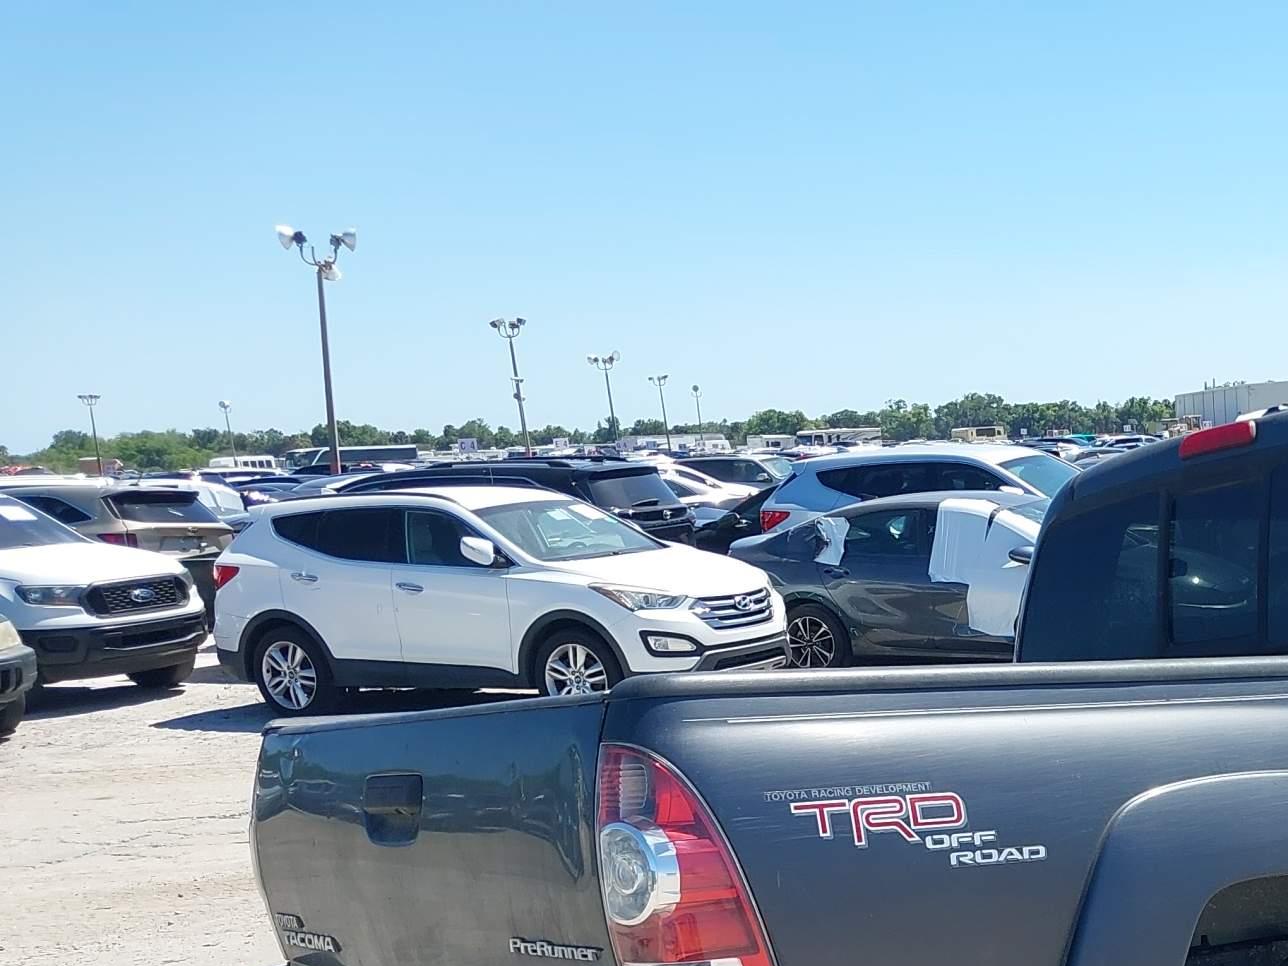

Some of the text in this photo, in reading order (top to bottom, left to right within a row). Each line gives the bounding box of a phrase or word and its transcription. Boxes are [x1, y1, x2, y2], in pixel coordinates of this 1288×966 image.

[765, 782, 931, 801] TOYOTA RACING DEVELOPMENT
[790, 792, 967, 847] TRD
[924, 830, 997, 849] OFF
[950, 845, 1047, 867] ROAD
[275, 914, 299, 929] TOYOTA
[282, 931, 335, 953] TACOMA
[509, 938, 599, 961] PreRunner
